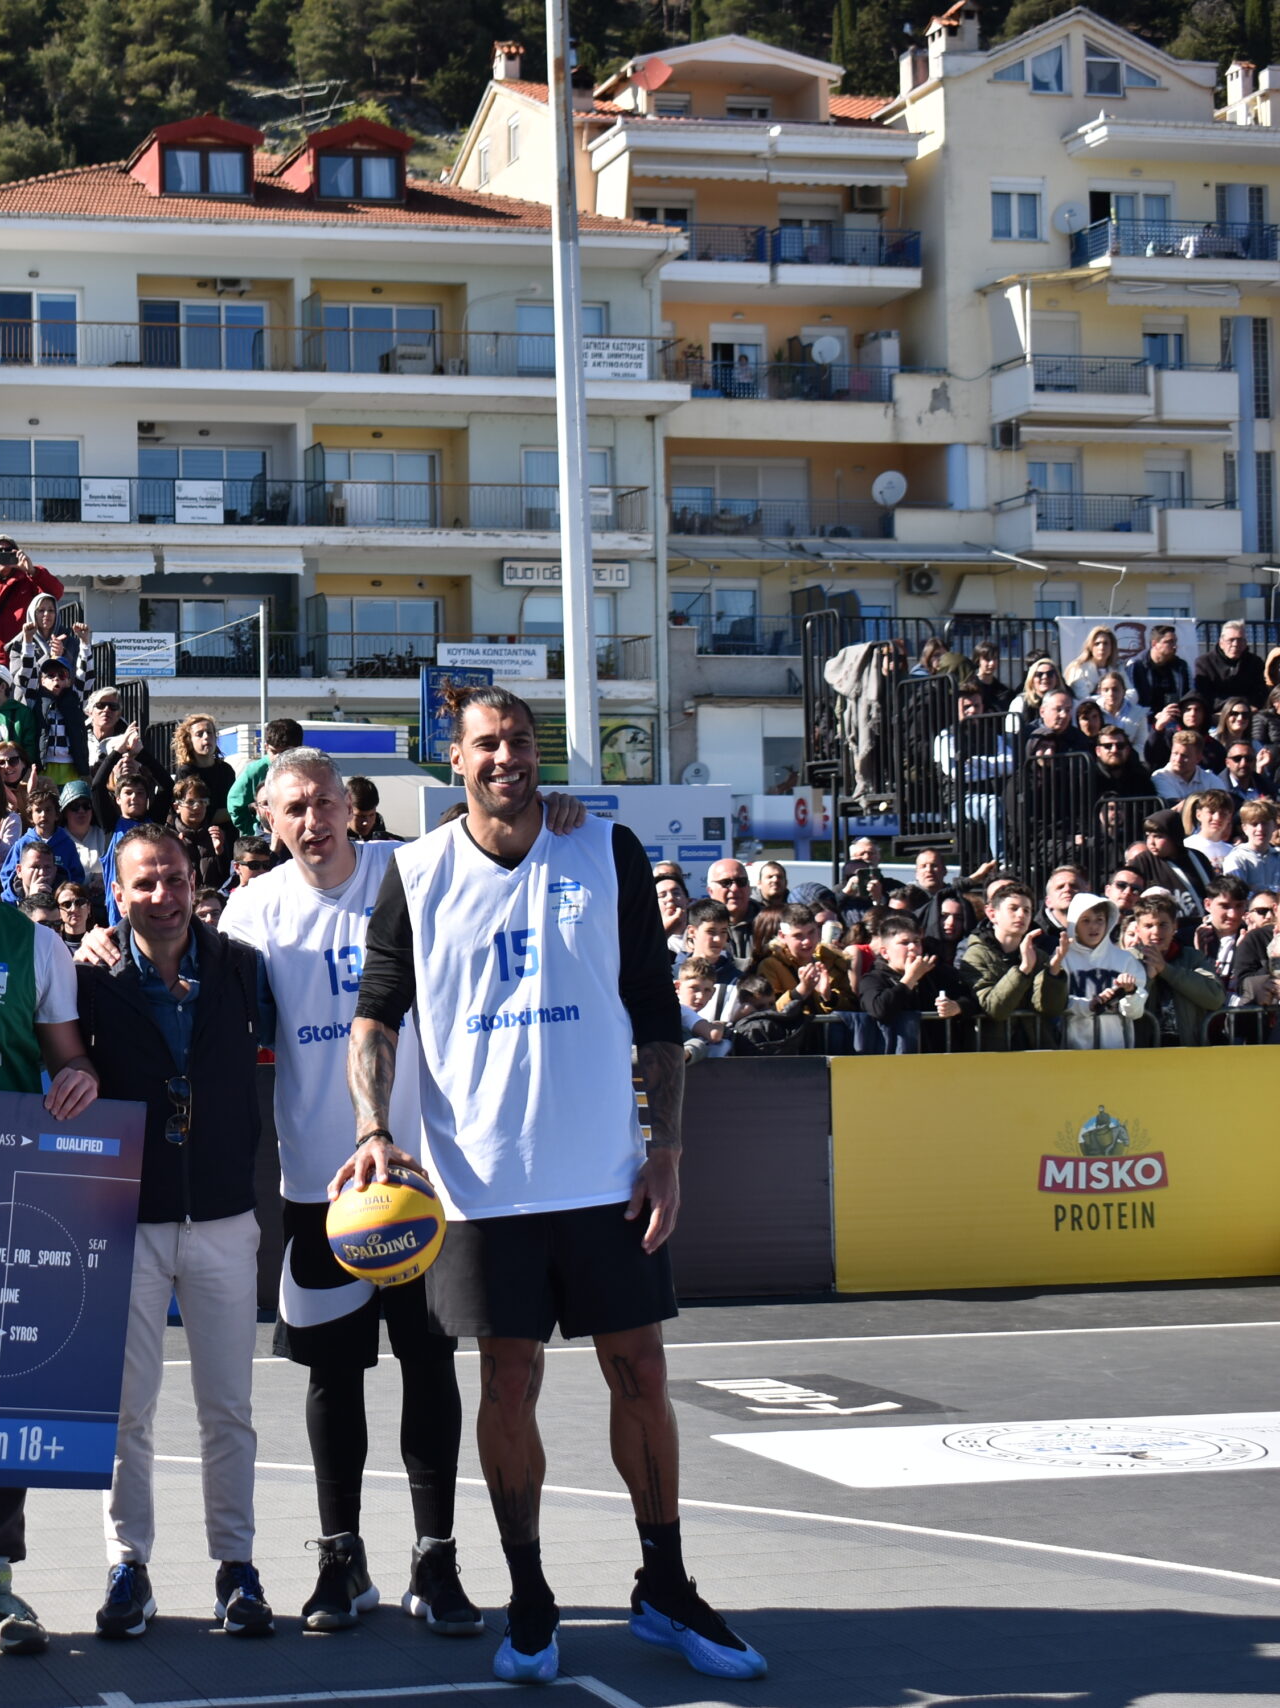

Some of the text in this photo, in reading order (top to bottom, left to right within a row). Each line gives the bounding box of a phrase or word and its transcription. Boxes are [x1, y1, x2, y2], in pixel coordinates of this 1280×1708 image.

[447, 648, 537, 657] ΚΟΥΤΙΝΑ ΚΩΝΣΤΑΝΤΙΝΑ
[493, 928, 540, 982] 15
[324, 945, 365, 996] 13
[466, 1003, 580, 1035] Stoiximan
[56, 1136, 103, 1153] QUALIFIED
[1044, 1157, 1163, 1190] MISKO
[1055, 1201, 1155, 1232] PROTEIN
[88, 1238, 107, 1250] SEAT
[342, 1230, 417, 1260] SPALDING
[87, 1253, 99, 1268] 01
[0, 1288, 20, 1304] JUNE
[9, 1326, 38, 1342] SYROS
[18, 1425, 65, 1462] 18+
